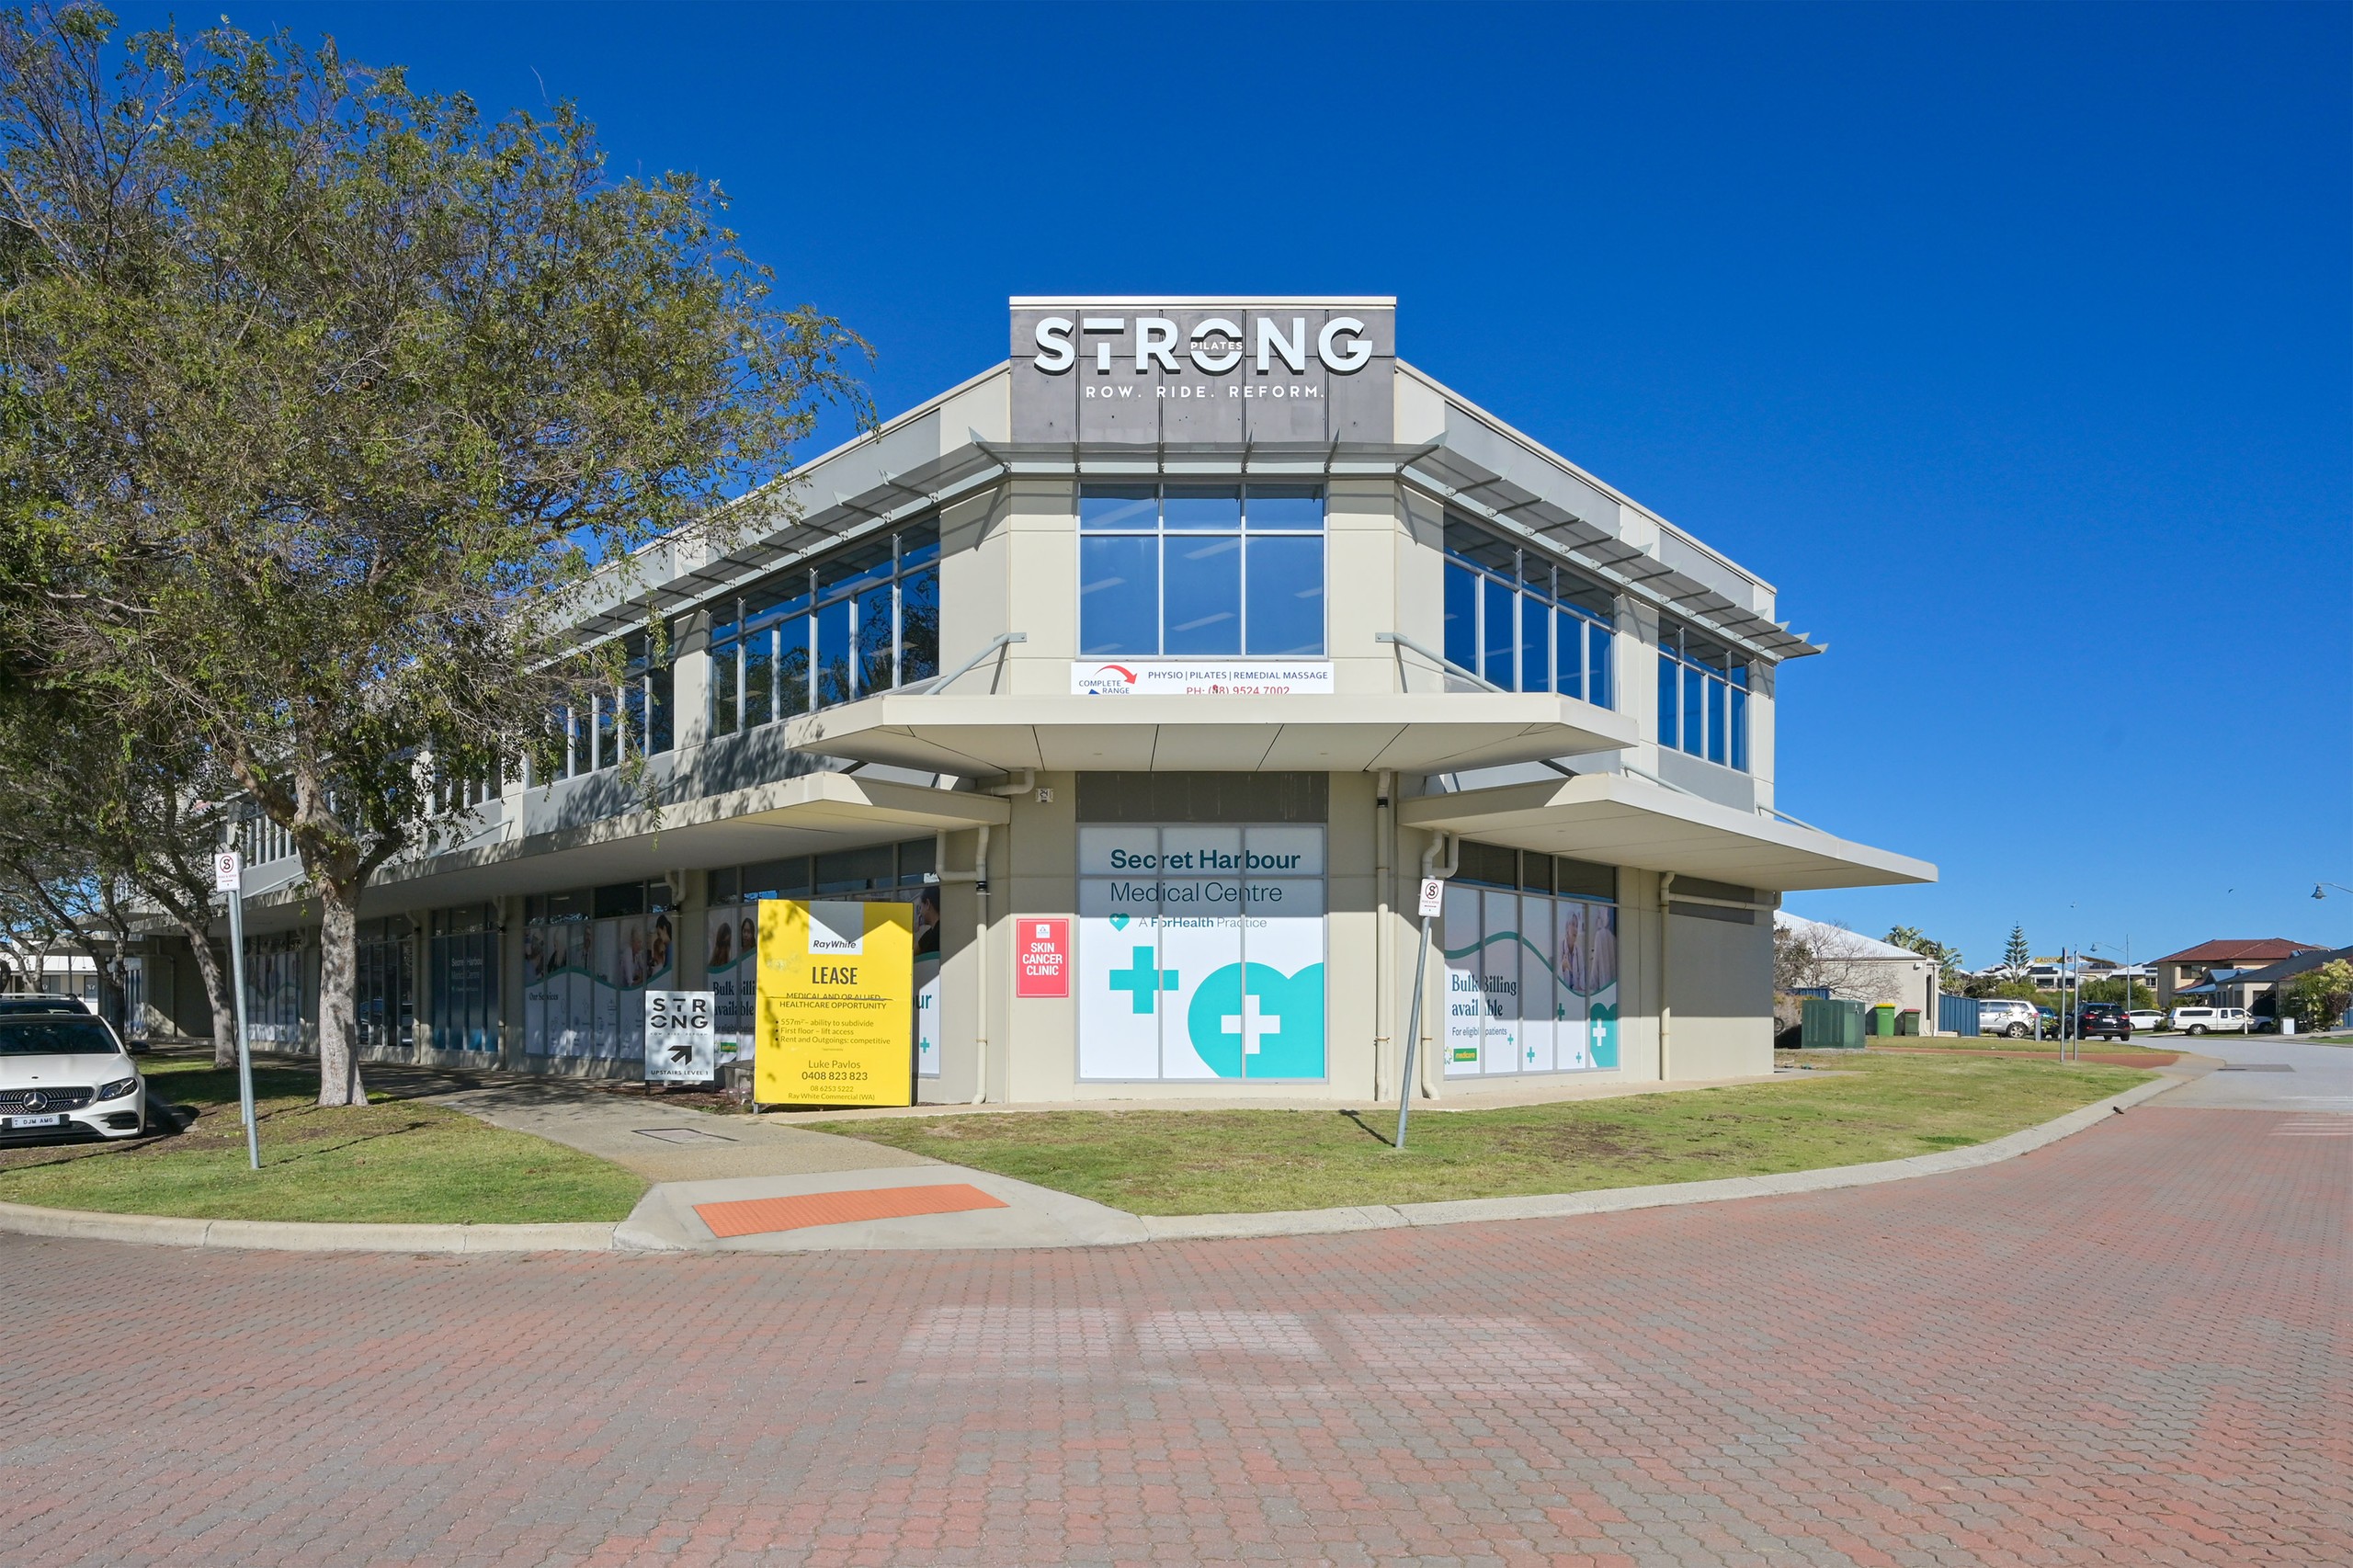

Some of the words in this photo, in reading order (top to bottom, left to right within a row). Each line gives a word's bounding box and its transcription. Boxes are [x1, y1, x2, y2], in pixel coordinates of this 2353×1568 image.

[1035, 317, 1373, 374] STRONG
[1190, 341, 1244, 350] PILATES
[1086, 385, 1142, 398] ROW.
[1156, 385, 1215, 398] RIDE.
[1229, 385, 1325, 398] REFORM.
[1148, 671, 1184, 679] PHYSIO
[1189, 671, 1227, 679] PILATES
[1283, 672, 1328, 680] MASSAGE
[1233, 686, 1260, 695] 9524
[1263, 686, 1290, 695] 7002
[1110, 849, 1194, 869] Secret
[1199, 849, 1302, 869] Harbour
[1111, 881, 1199, 902] Medical
[1205, 881, 1283, 902] Centre
[1138, 917, 1148, 927] A
[1217, 916, 1267, 928] Practice
[1030, 942, 1055, 953] SKIN
[1022, 954, 1063, 964] CANCER
[812, 966, 858, 985] LEASE
[1026, 965, 1060, 976] CLINIC
[1451, 974, 1479, 993] Bulk
[779, 1001, 830, 1009] HEALTHCARE
[1451, 999, 1503, 1017] availble
[810, 1019, 832, 1028] ability
[841, 1019, 874, 1028] subdivide
[812, 1037, 849, 1045] Outgoings:
[850, 1037, 891, 1045] competitive
[808, 1060, 830, 1069] Luke
[832, 1060, 861, 1069] Pavlos
[801, 1071, 826, 1080] 0408
[828, 1072, 847, 1081] 823
[849, 1072, 868, 1081] 823
